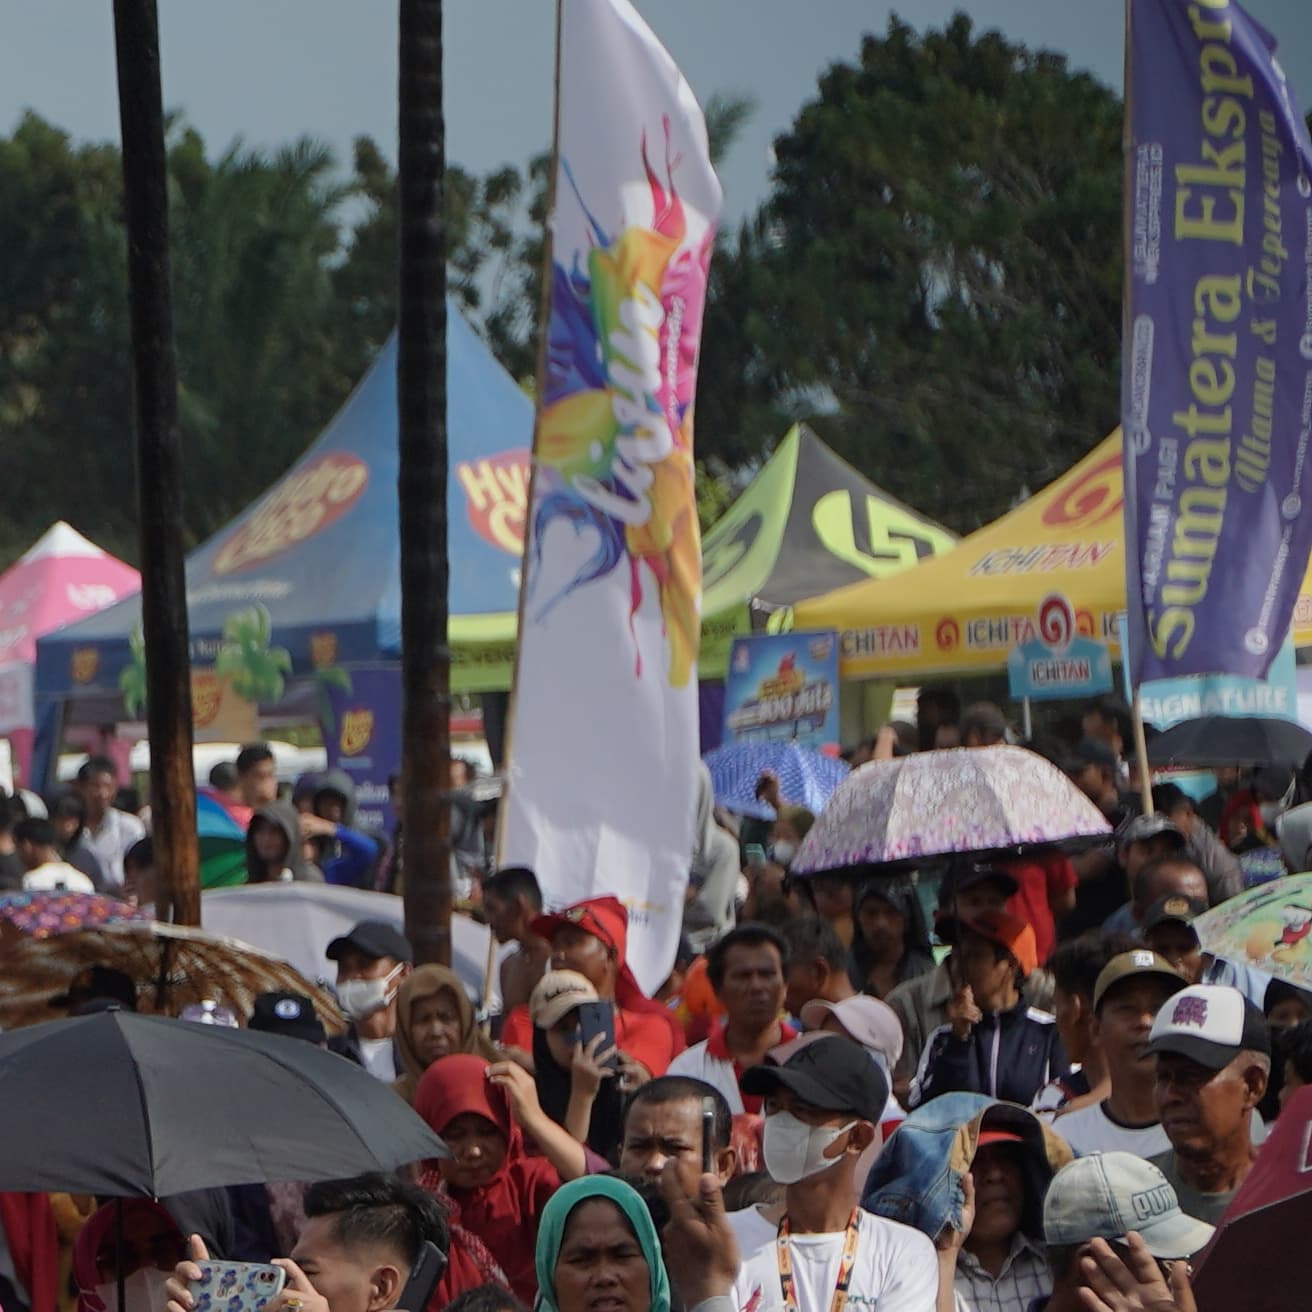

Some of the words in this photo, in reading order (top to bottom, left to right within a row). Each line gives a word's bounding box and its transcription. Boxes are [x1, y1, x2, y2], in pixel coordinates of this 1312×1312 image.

[1149, 274, 1242, 660] Sumatera
[840, 624, 919, 657] CHITAN
[967, 612, 1037, 646] ICHITA
[1031, 660, 1092, 684] ICHITAN
[1139, 686, 1286, 721] SIGNATURE
[1132, 1188, 1179, 1222] PUM
